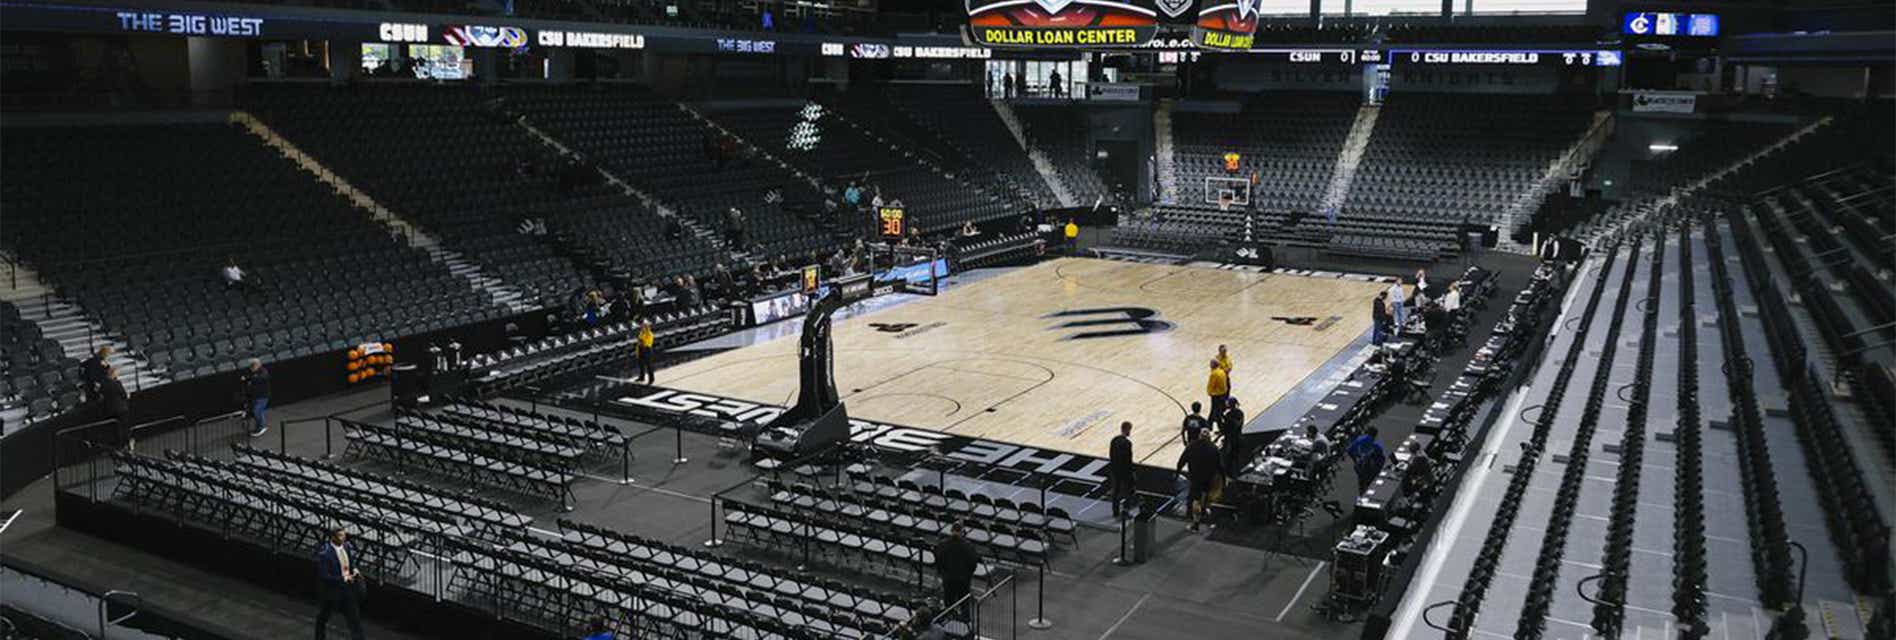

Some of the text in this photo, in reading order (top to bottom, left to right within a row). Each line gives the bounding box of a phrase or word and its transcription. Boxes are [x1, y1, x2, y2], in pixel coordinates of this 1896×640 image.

[117, 12, 263, 36] THE BIG WEST
[380, 22, 428, 42] CSUN
[538, 30, 645, 49] CSU BAKERSFIELD
[985, 29, 1136, 44] DOLLAR LOAN CENTER
[717, 39, 735, 50] THE
[915, 47, 992, 58] BAKERSFIELD
[1290, 52, 1321, 62] CSUN
[1425, 53, 1449, 63] CSU
[1451, 53, 1539, 63] BAKERSFIELD
[882, 219, 900, 235] 30
[946, 439, 1111, 483] THE
